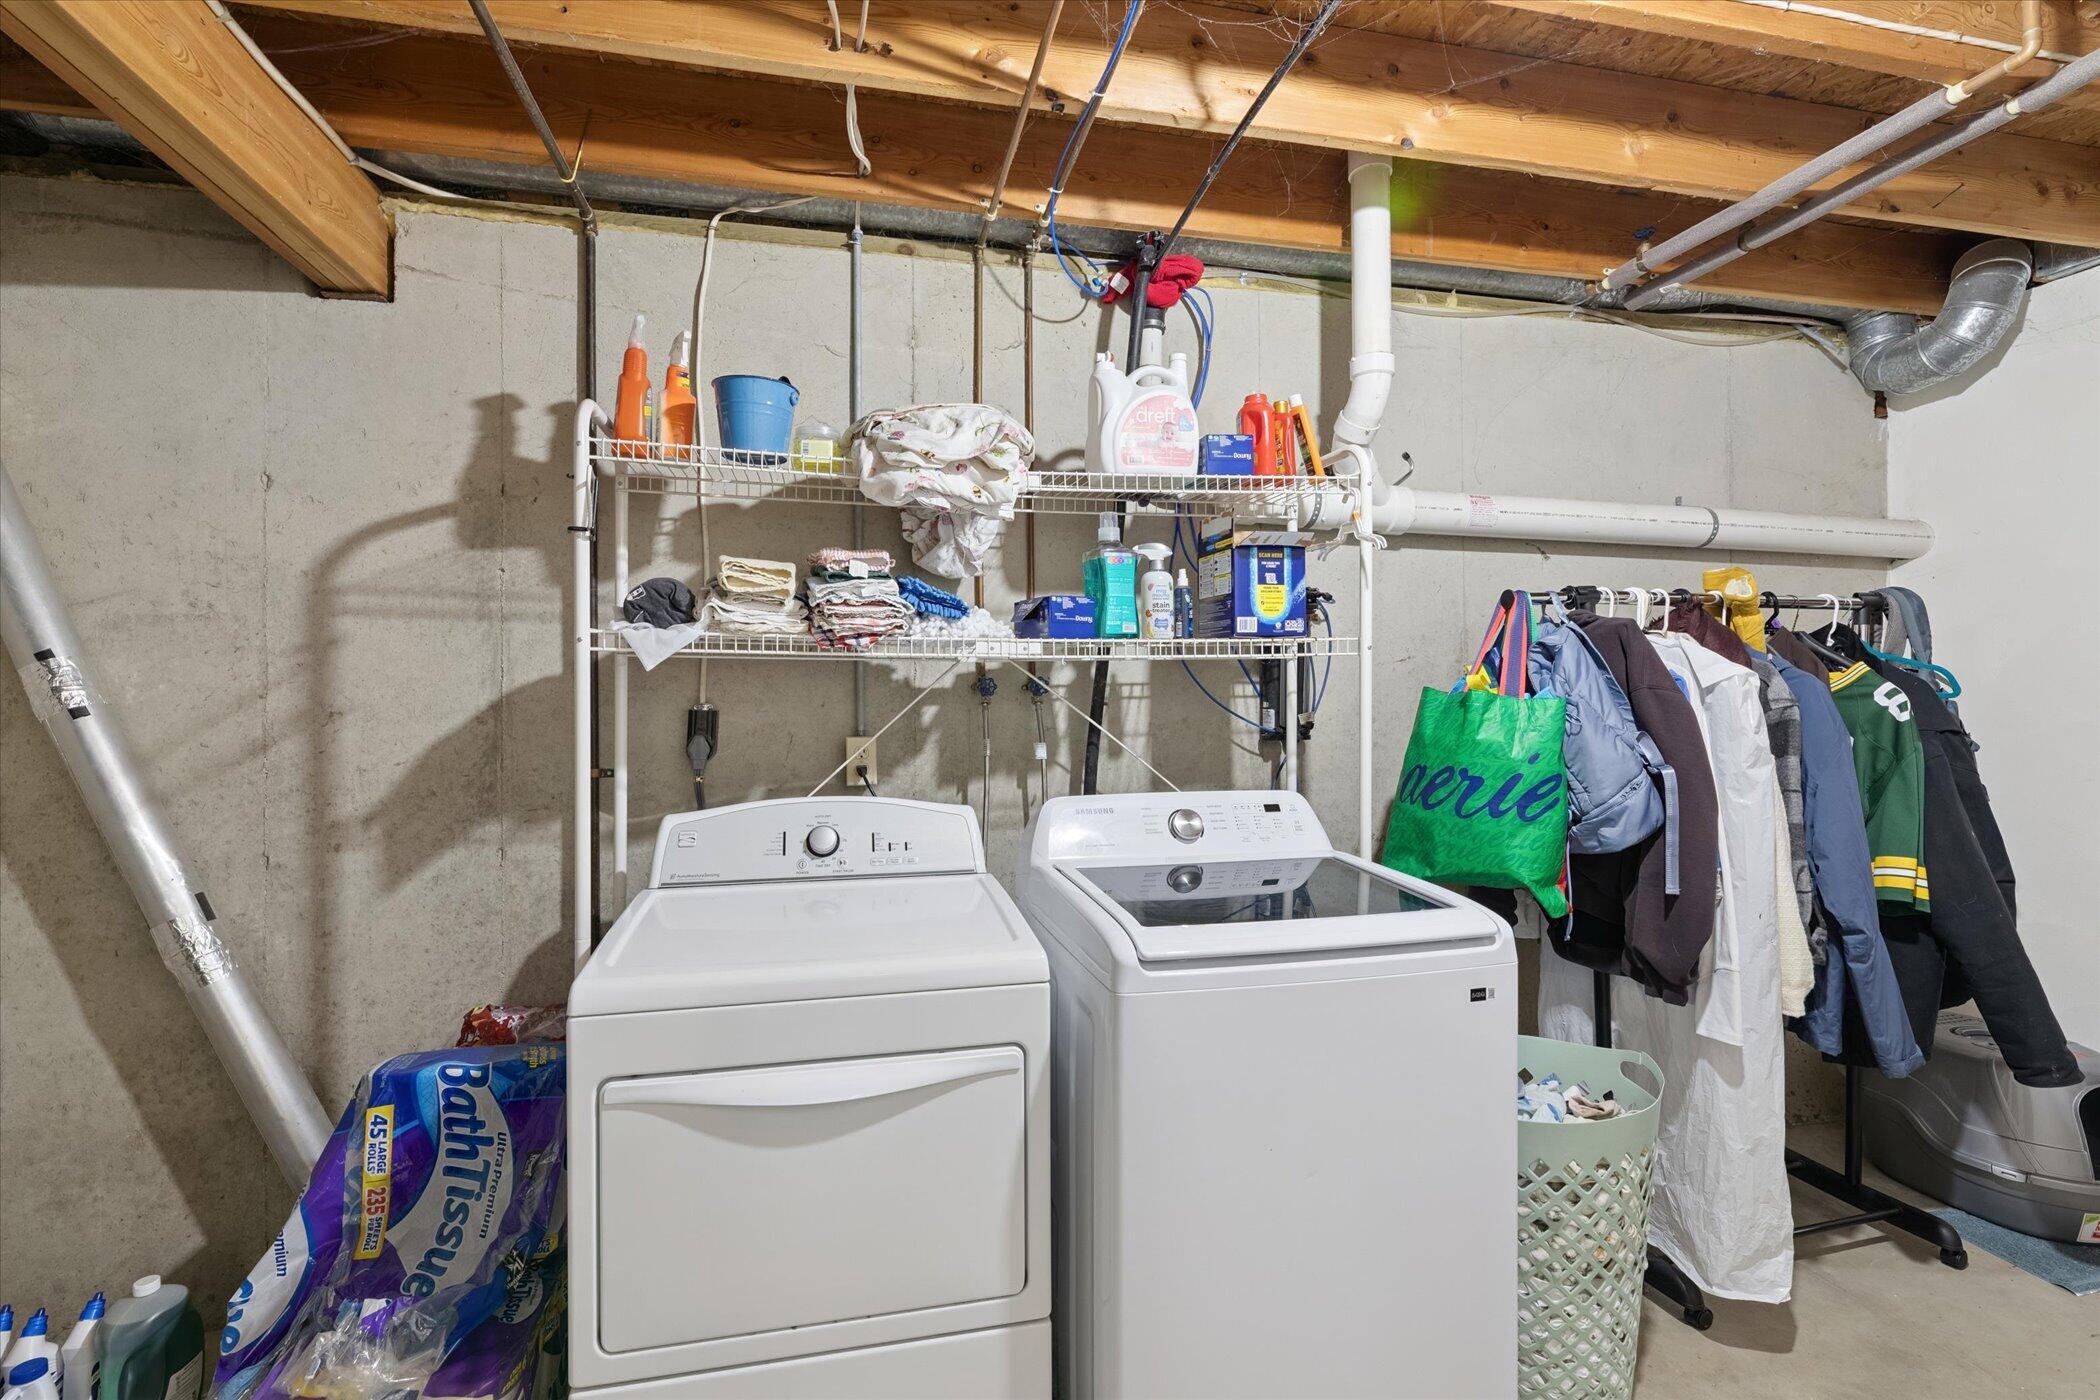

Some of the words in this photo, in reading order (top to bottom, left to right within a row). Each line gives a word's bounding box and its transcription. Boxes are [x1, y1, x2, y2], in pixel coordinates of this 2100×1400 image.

[1136, 406, 1176, 423] dreft
[1233, 452, 1252, 460] Downy
[1075, 615, 1093, 623] Downy
[1400, 752, 1563, 822] aerie
[1075, 807, 1114, 815] SAMSUNG
[370, 1115, 388, 1139] 45
[377, 1141, 387, 1173] LARGE
[495, 1132, 507, 1168] Ultra
[366, 1188, 386, 1214] 235
[479, 1169, 502, 1239] Premium
[363, 1232, 372, 1252] ROLL
[370, 1217, 383, 1251] SHEETS
